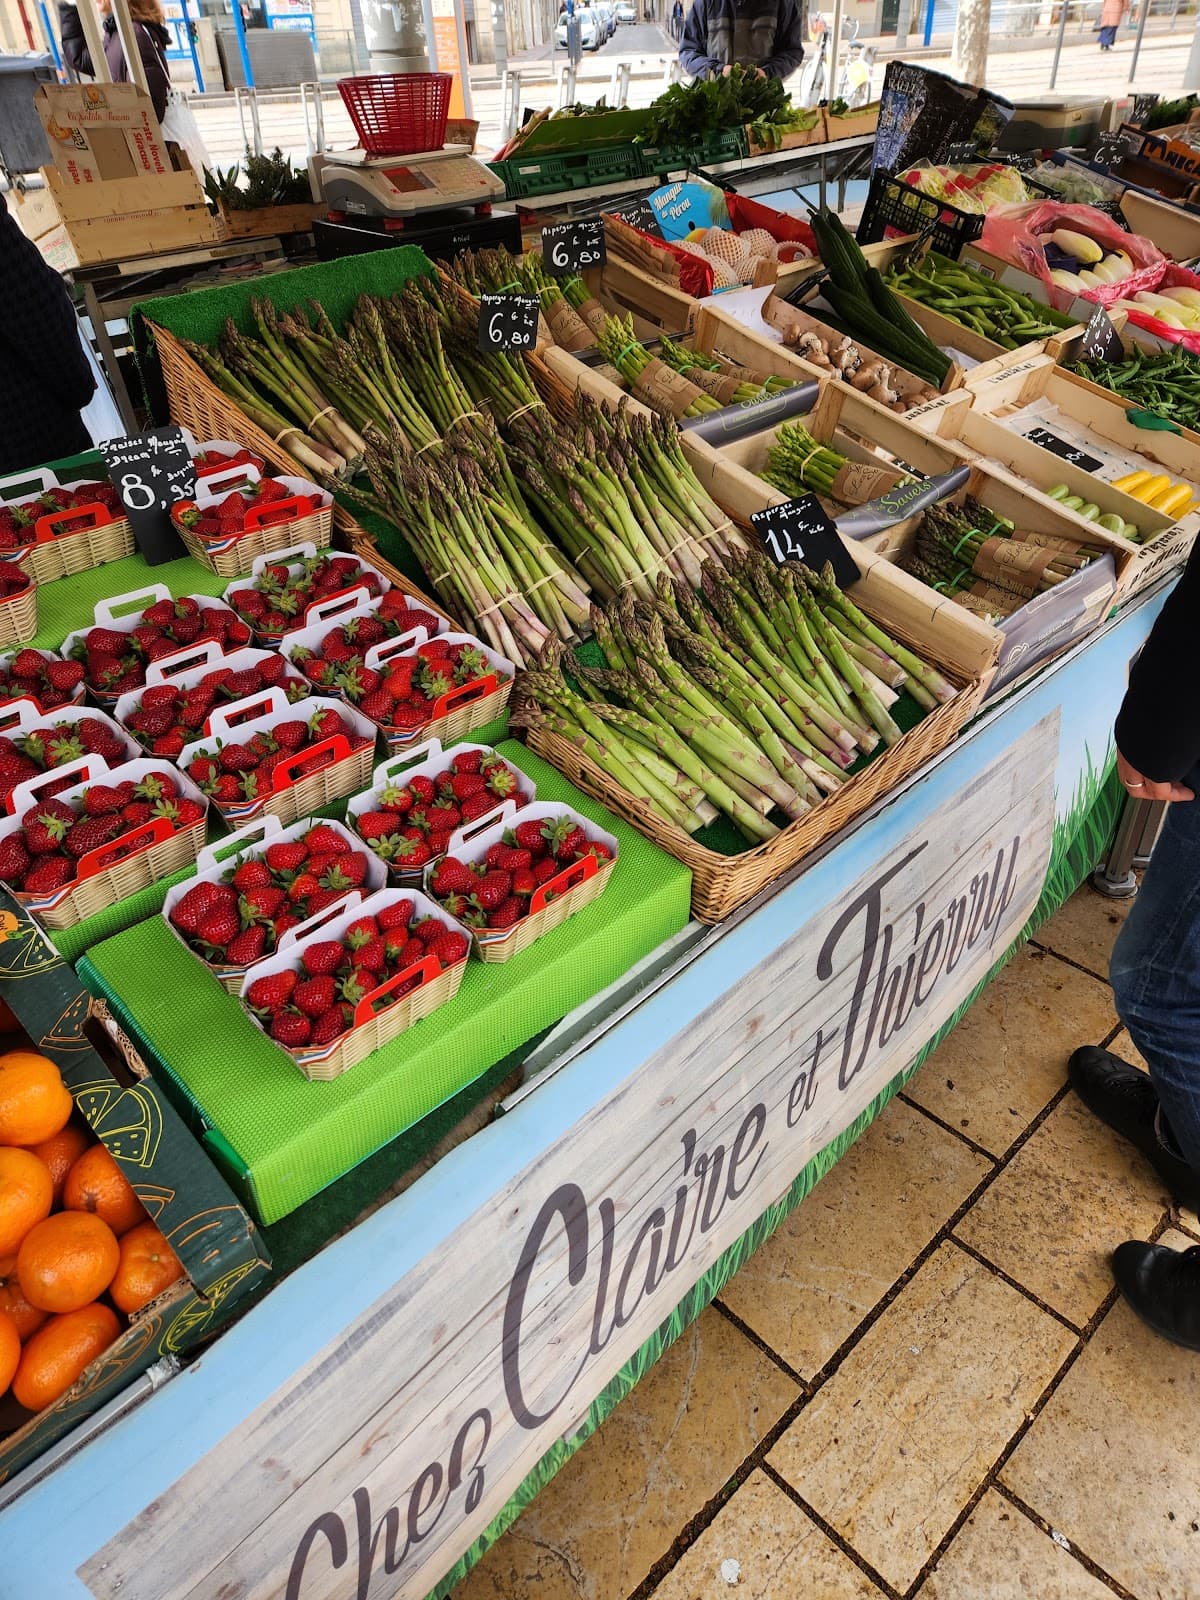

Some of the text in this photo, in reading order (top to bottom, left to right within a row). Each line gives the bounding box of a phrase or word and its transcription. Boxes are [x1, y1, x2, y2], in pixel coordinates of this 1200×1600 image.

[653, 182, 684, 212] Mangue
[669, 198, 692, 220] Pérou
[765, 528, 805, 563] 14
[285, 836, 1020, 1600] Chez Claire et Thierry
